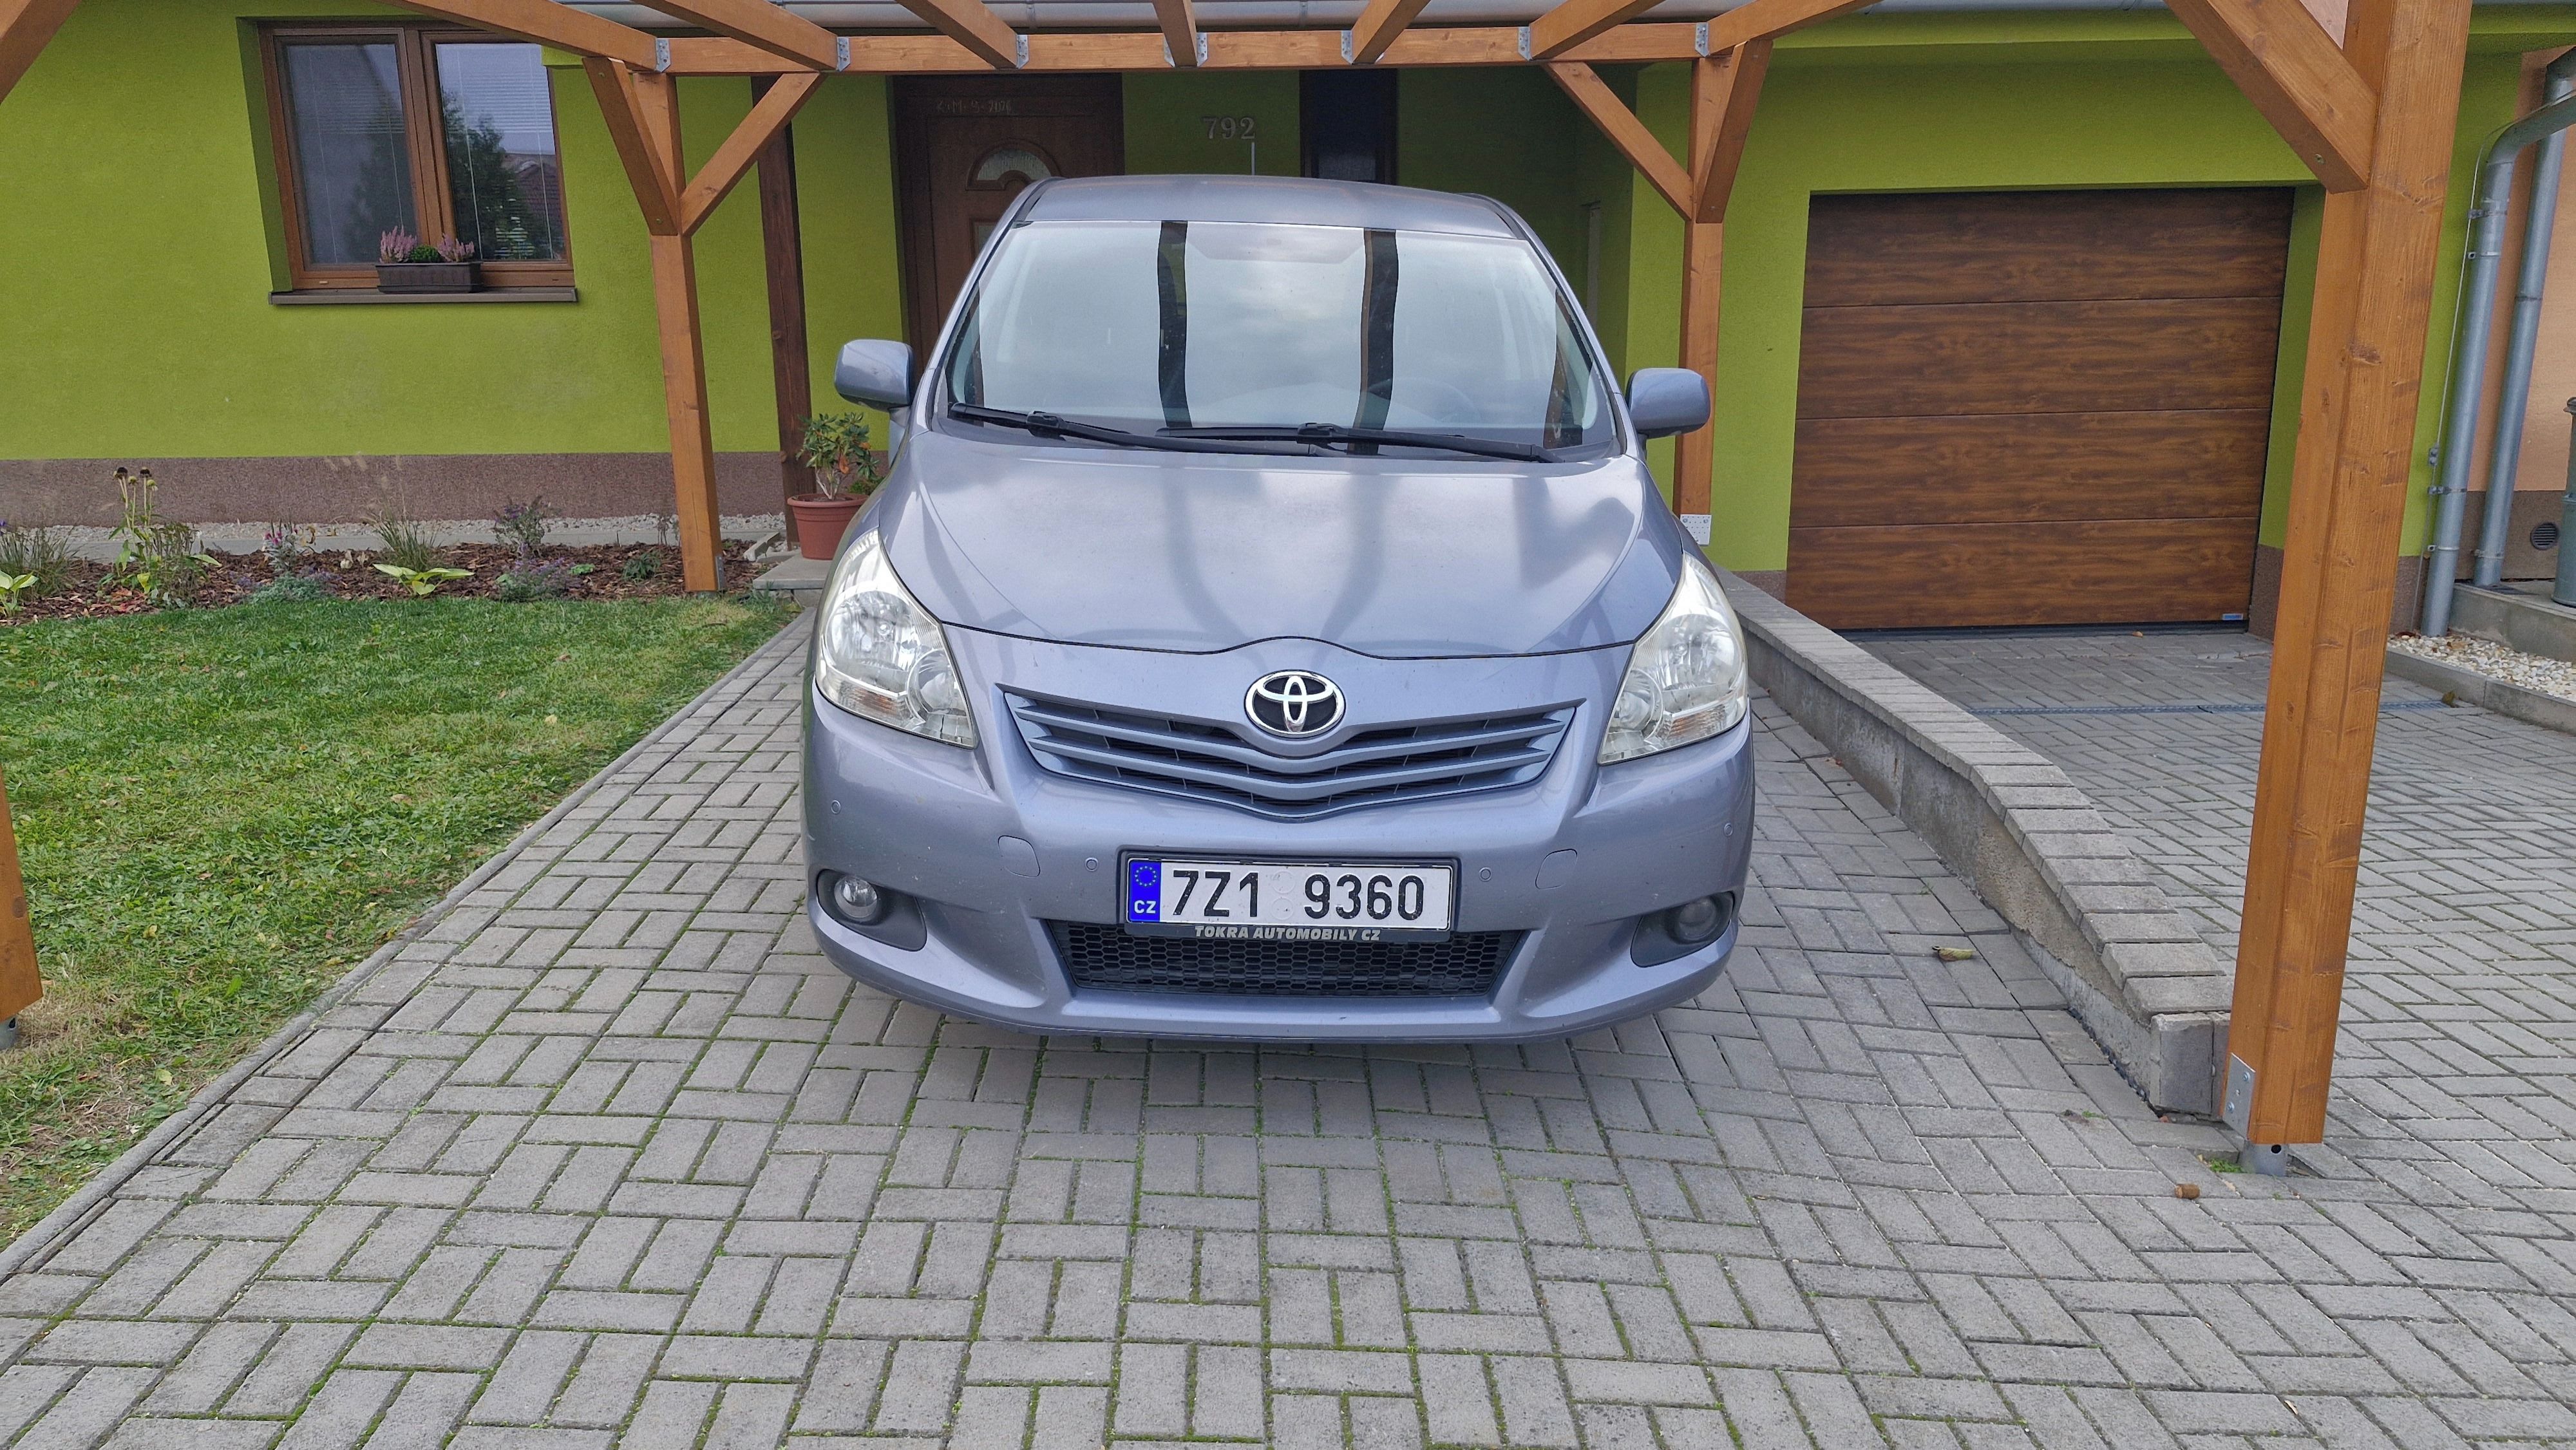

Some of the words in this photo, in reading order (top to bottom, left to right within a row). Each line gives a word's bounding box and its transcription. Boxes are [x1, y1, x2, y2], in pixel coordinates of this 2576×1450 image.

[1202, 117, 1255, 140] 792
[1173, 870, 1258, 918] 7Z1
[1304, 874, 1425, 921] 9360
[1134, 899, 1157, 914] CZ
[1195, 925, 1249, 939] TOKRA
[1253, 927, 1359, 941] AUTOMOBILY
[1361, 928, 1381, 941] CZ
